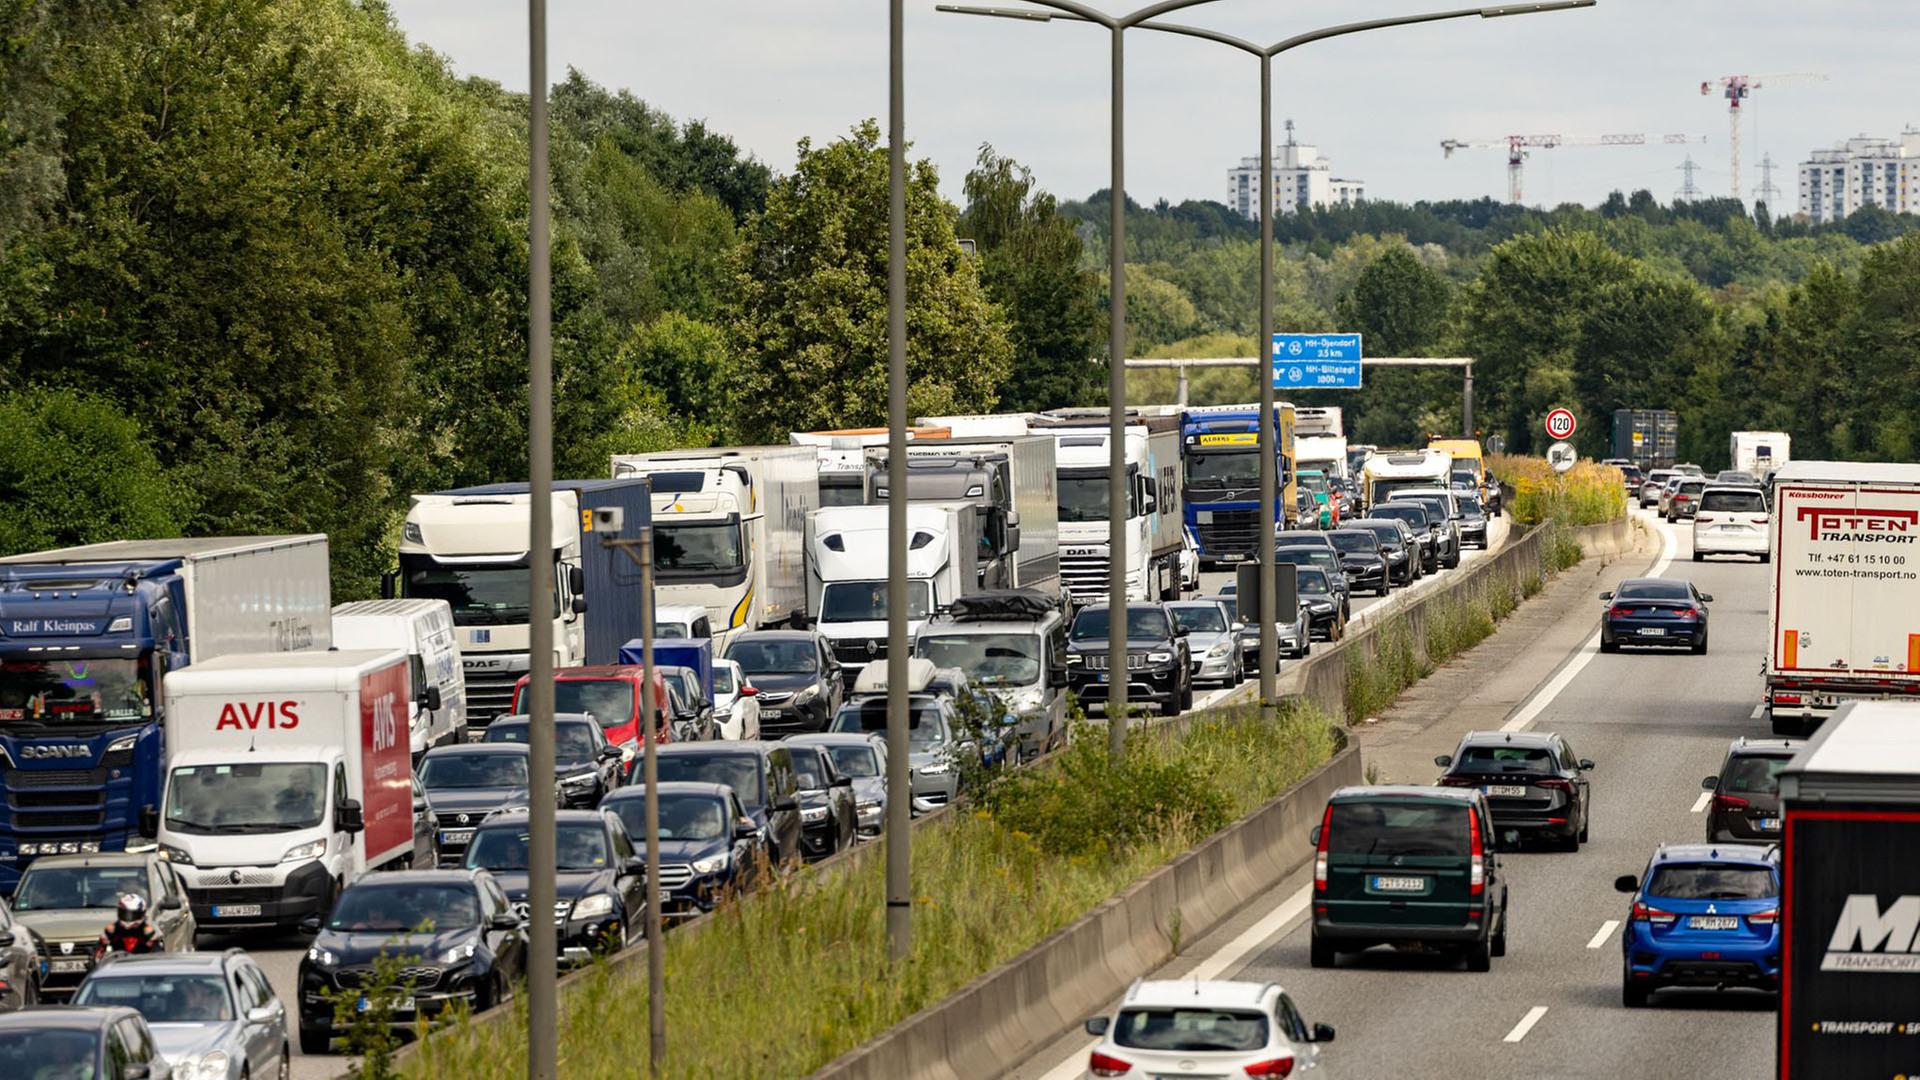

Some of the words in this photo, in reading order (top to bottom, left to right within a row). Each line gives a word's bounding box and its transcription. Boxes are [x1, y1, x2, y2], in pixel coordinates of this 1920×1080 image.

[1331, 349, 1342, 357] km
[1318, 376, 1335, 384] 1000
[1553, 418, 1569, 430] 120
[1797, 507, 1918, 541] TOTEN
[1821, 532, 1918, 544] TRANSPORT
[1808, 553, 1824, 563] Tlf.
[1827, 554, 1845, 563] +47
[1848, 554, 1860, 563] 61
[1864, 555, 1876, 564] 15
[1880, 555, 1890, 564] 10
[1893, 556, 1905, 565] 00
[1795, 568, 1917, 580] www.toten-transport.no
[13, 620, 39, 632] Ralf
[44, 620, 96, 634] Kleinpas
[463, 660, 501, 668] DAF
[216, 700, 299, 731] AVIS
[373, 691, 396, 753] AVIS
[20, 744, 93, 758] SCANIA
[1834, 957, 1918, 968] TRANSPORT
[1821, 1021, 1894, 1034] TRANSPORT
